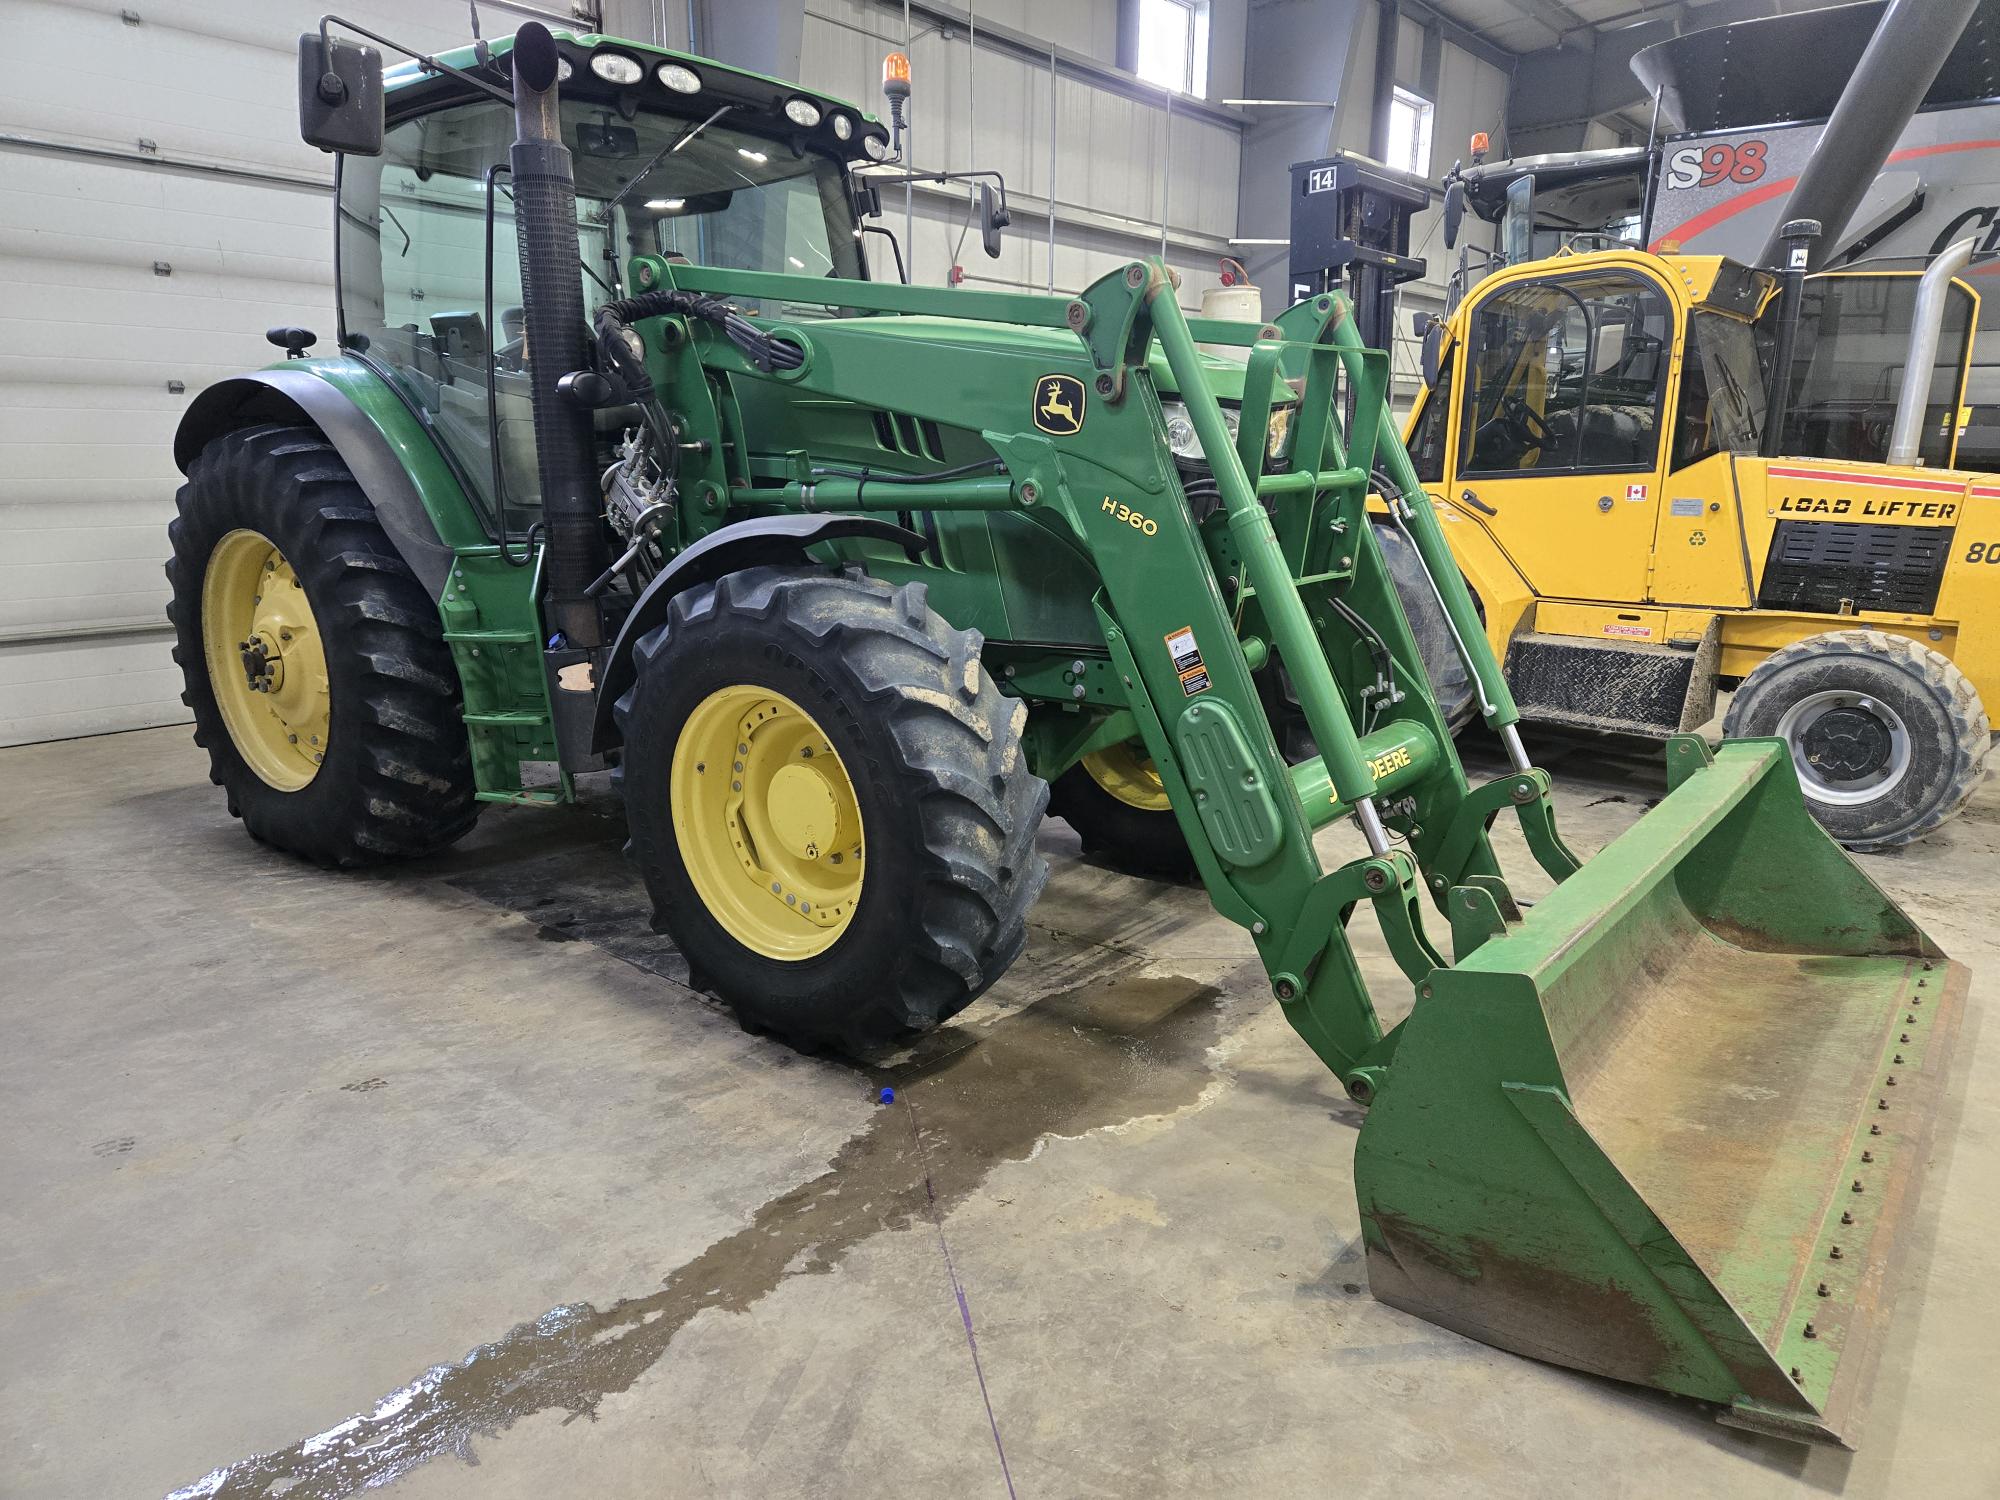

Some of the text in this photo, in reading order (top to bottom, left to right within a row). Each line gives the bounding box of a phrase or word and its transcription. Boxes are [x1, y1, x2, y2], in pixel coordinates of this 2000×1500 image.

[1312, 170, 1333, 190] 14
[1667, 140, 1768, 190] S98
[1101, 495, 1158, 536] H360
[1780, 496, 1851, 514] LOAD
